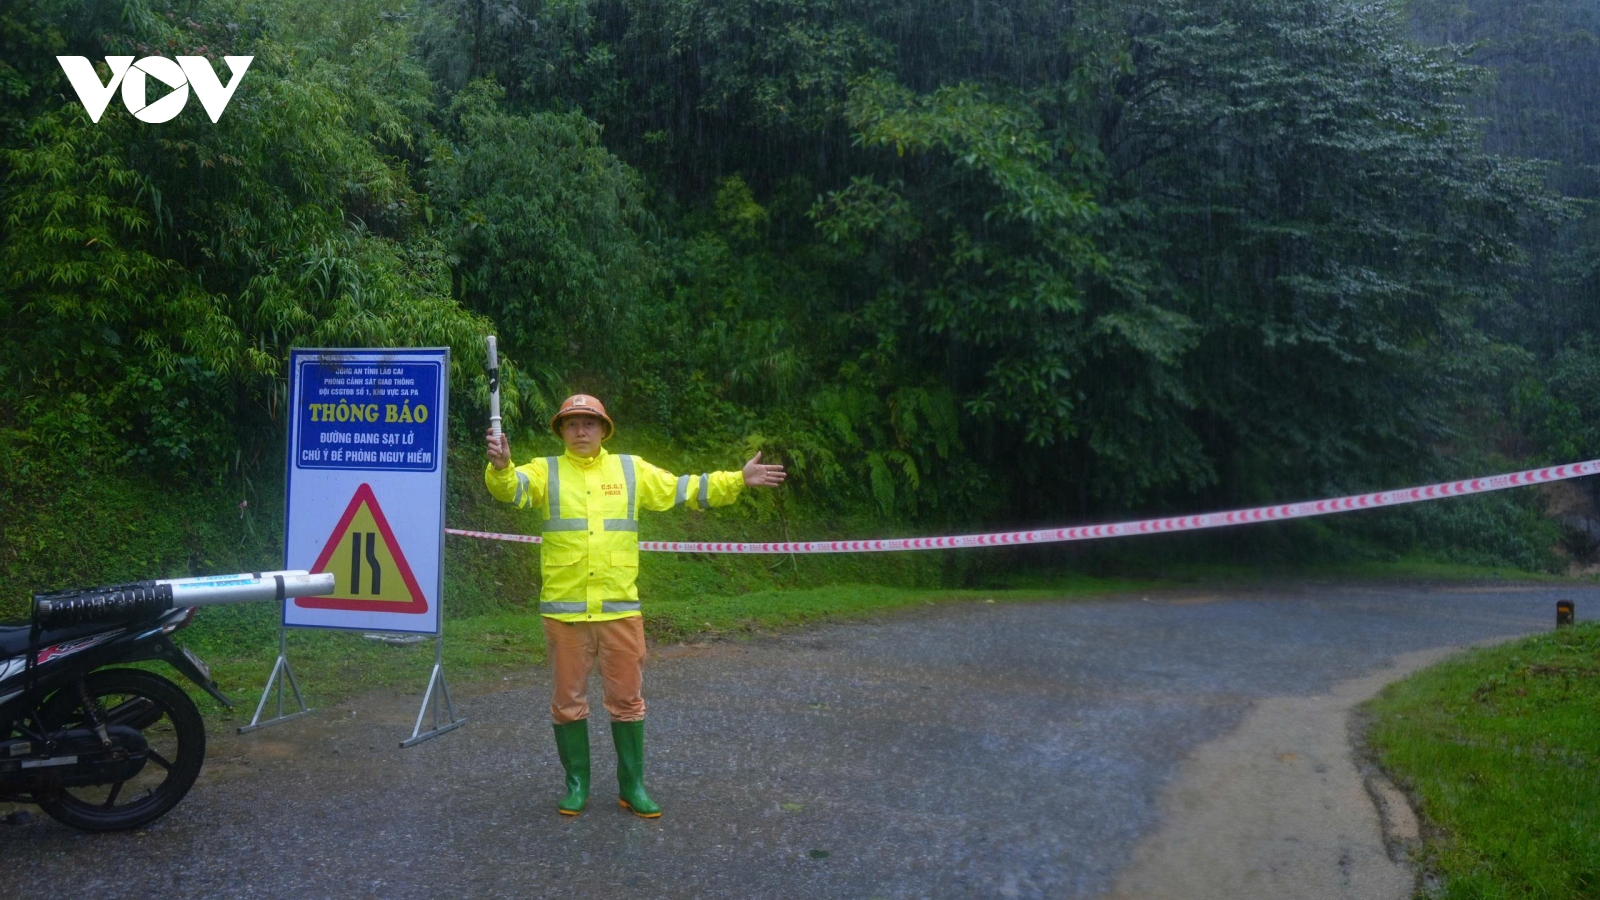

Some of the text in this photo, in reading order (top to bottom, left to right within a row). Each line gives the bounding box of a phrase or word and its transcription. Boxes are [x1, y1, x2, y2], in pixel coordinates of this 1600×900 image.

[355, 387, 364, 395] SỐ
[366, 388, 371, 396] 1,
[386, 388, 399, 397] VỰC
[400, 388, 409, 396] SA
[308, 398, 429, 424] THÔNG BÁO
[320, 429, 414, 447] ĐƯỜNG ĐANG SẠT LỞ
[302, 447, 321, 461] CHÚ
[323, 447, 329, 461] Ý
[345, 448, 377, 462] PHÒNG
[379, 451, 405, 463] NGUY
[407, 447, 432, 463] HIỂM
